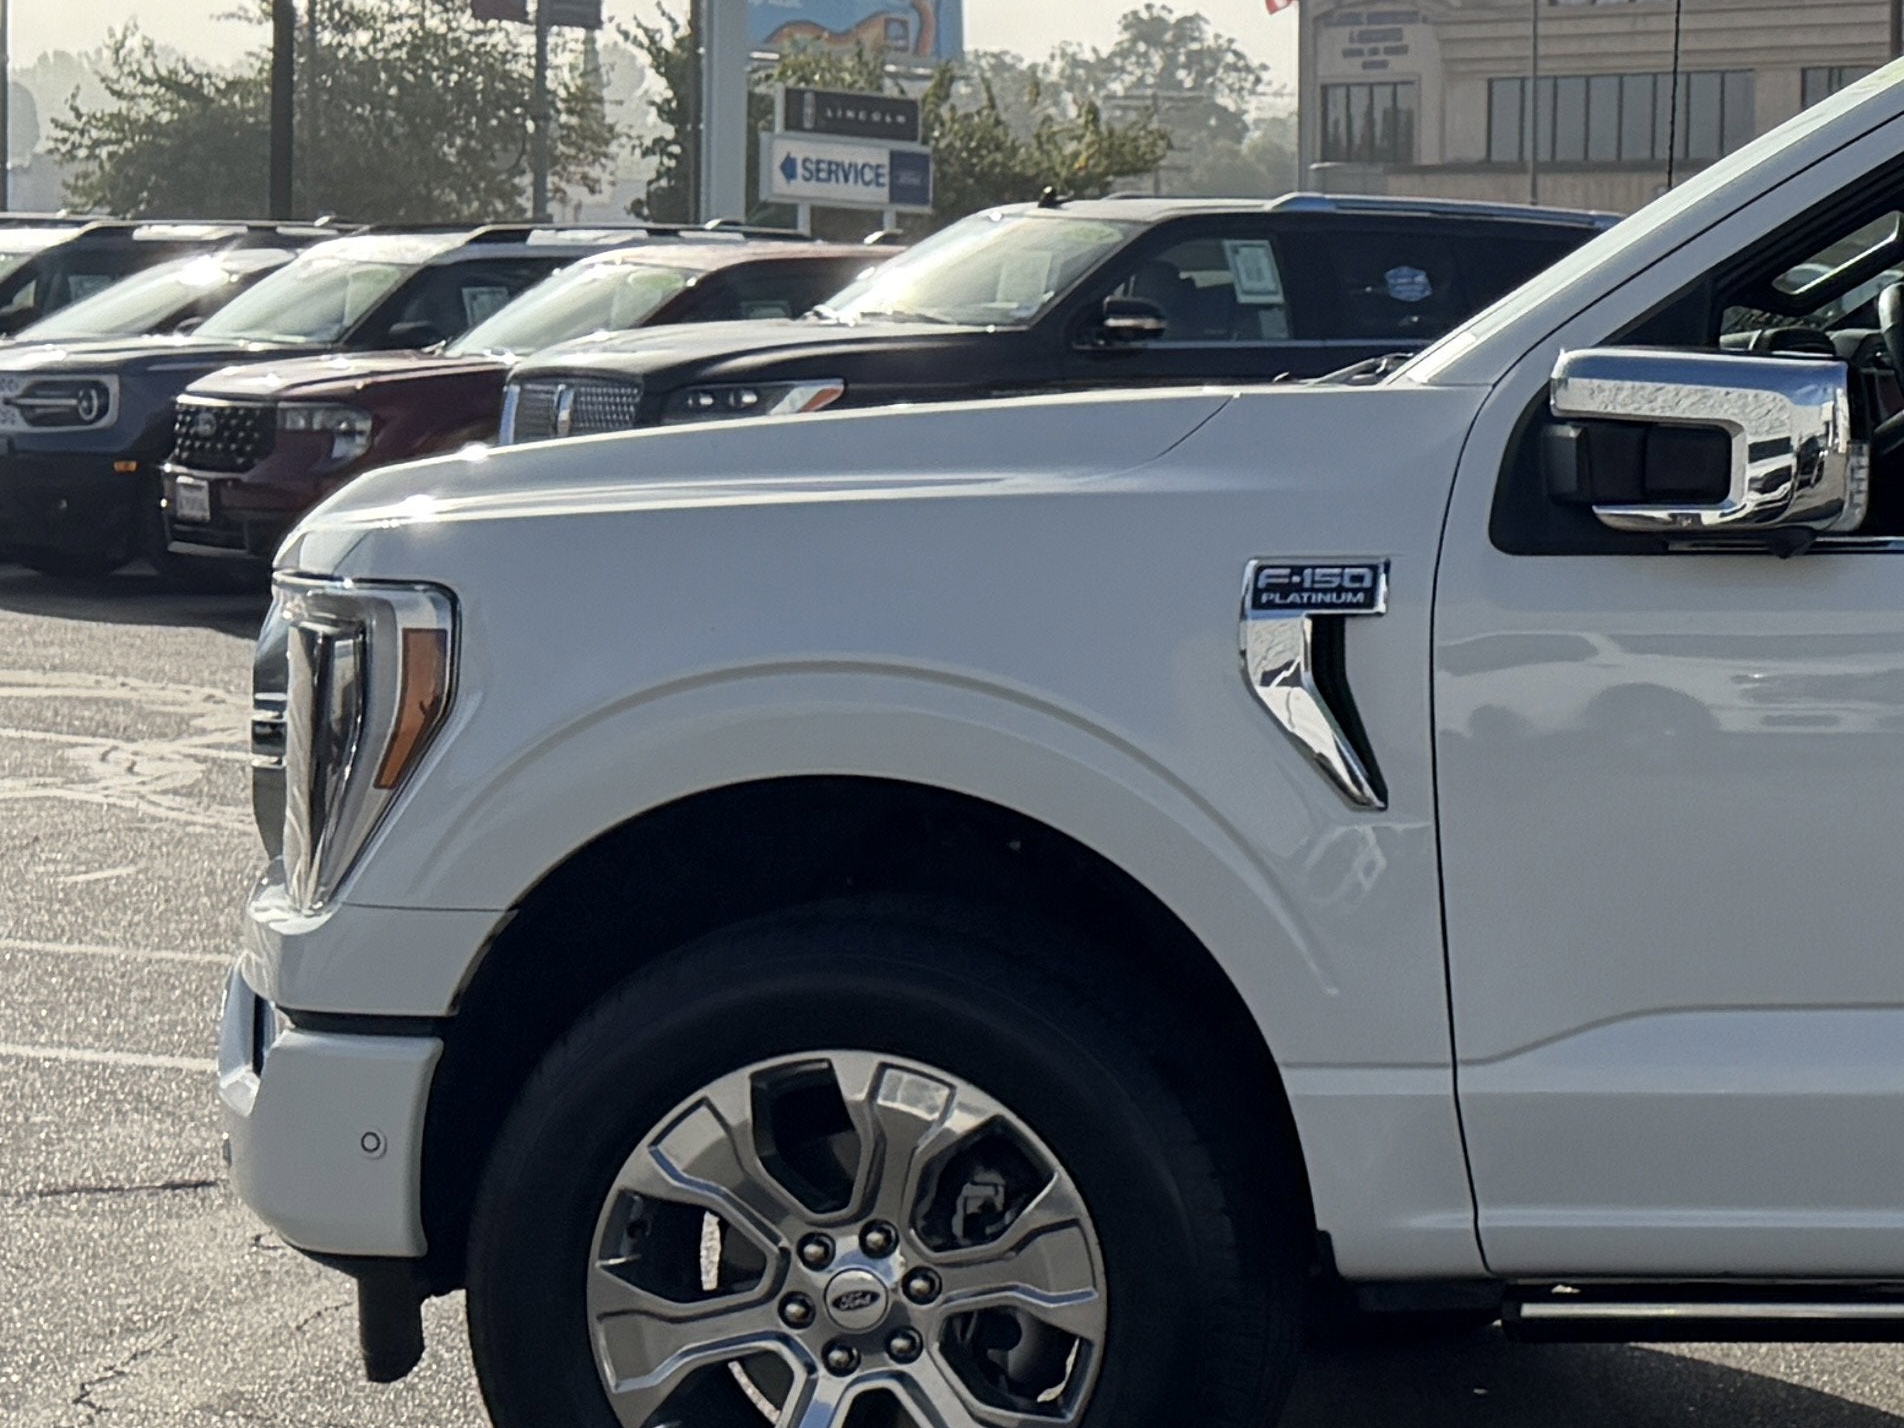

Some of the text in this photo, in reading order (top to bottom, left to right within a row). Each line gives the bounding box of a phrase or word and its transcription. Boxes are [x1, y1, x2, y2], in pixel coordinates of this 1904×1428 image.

[826, 107, 906, 123] LINCOLN
[801, 157, 886, 188] SERVICE
[1257, 567, 1374, 589] F-150
[1261, 591, 1365, 604] PLATINUM
